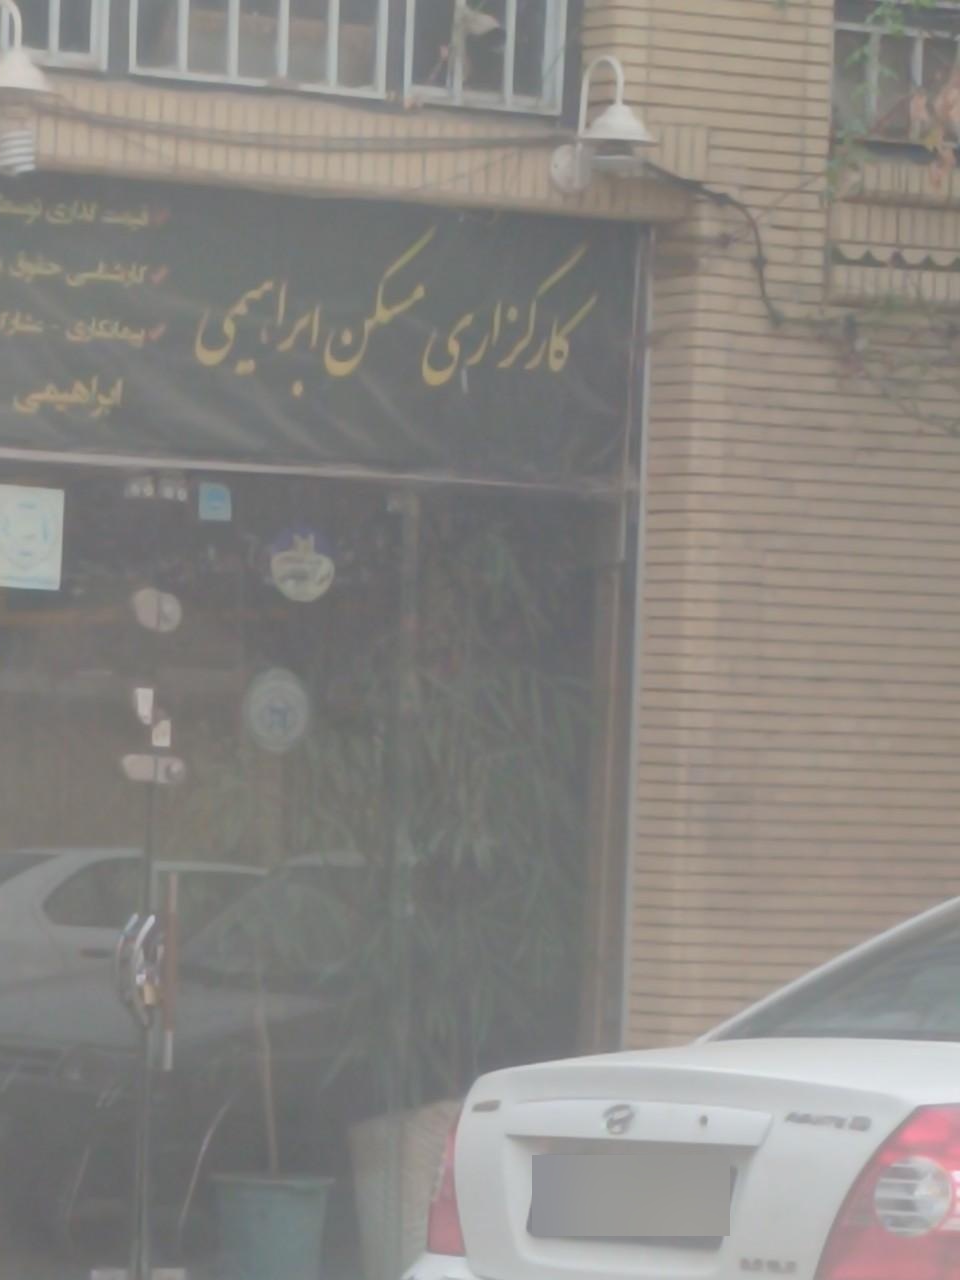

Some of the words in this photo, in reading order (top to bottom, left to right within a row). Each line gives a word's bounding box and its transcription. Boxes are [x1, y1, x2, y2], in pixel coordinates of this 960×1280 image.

[195, 278, 321, 397] ابراهیمی
[323, 225, 437, 377] مسکن
[421, 243, 599, 387] کارگزاری
[14, 376, 124, 417] ابراهیمی
